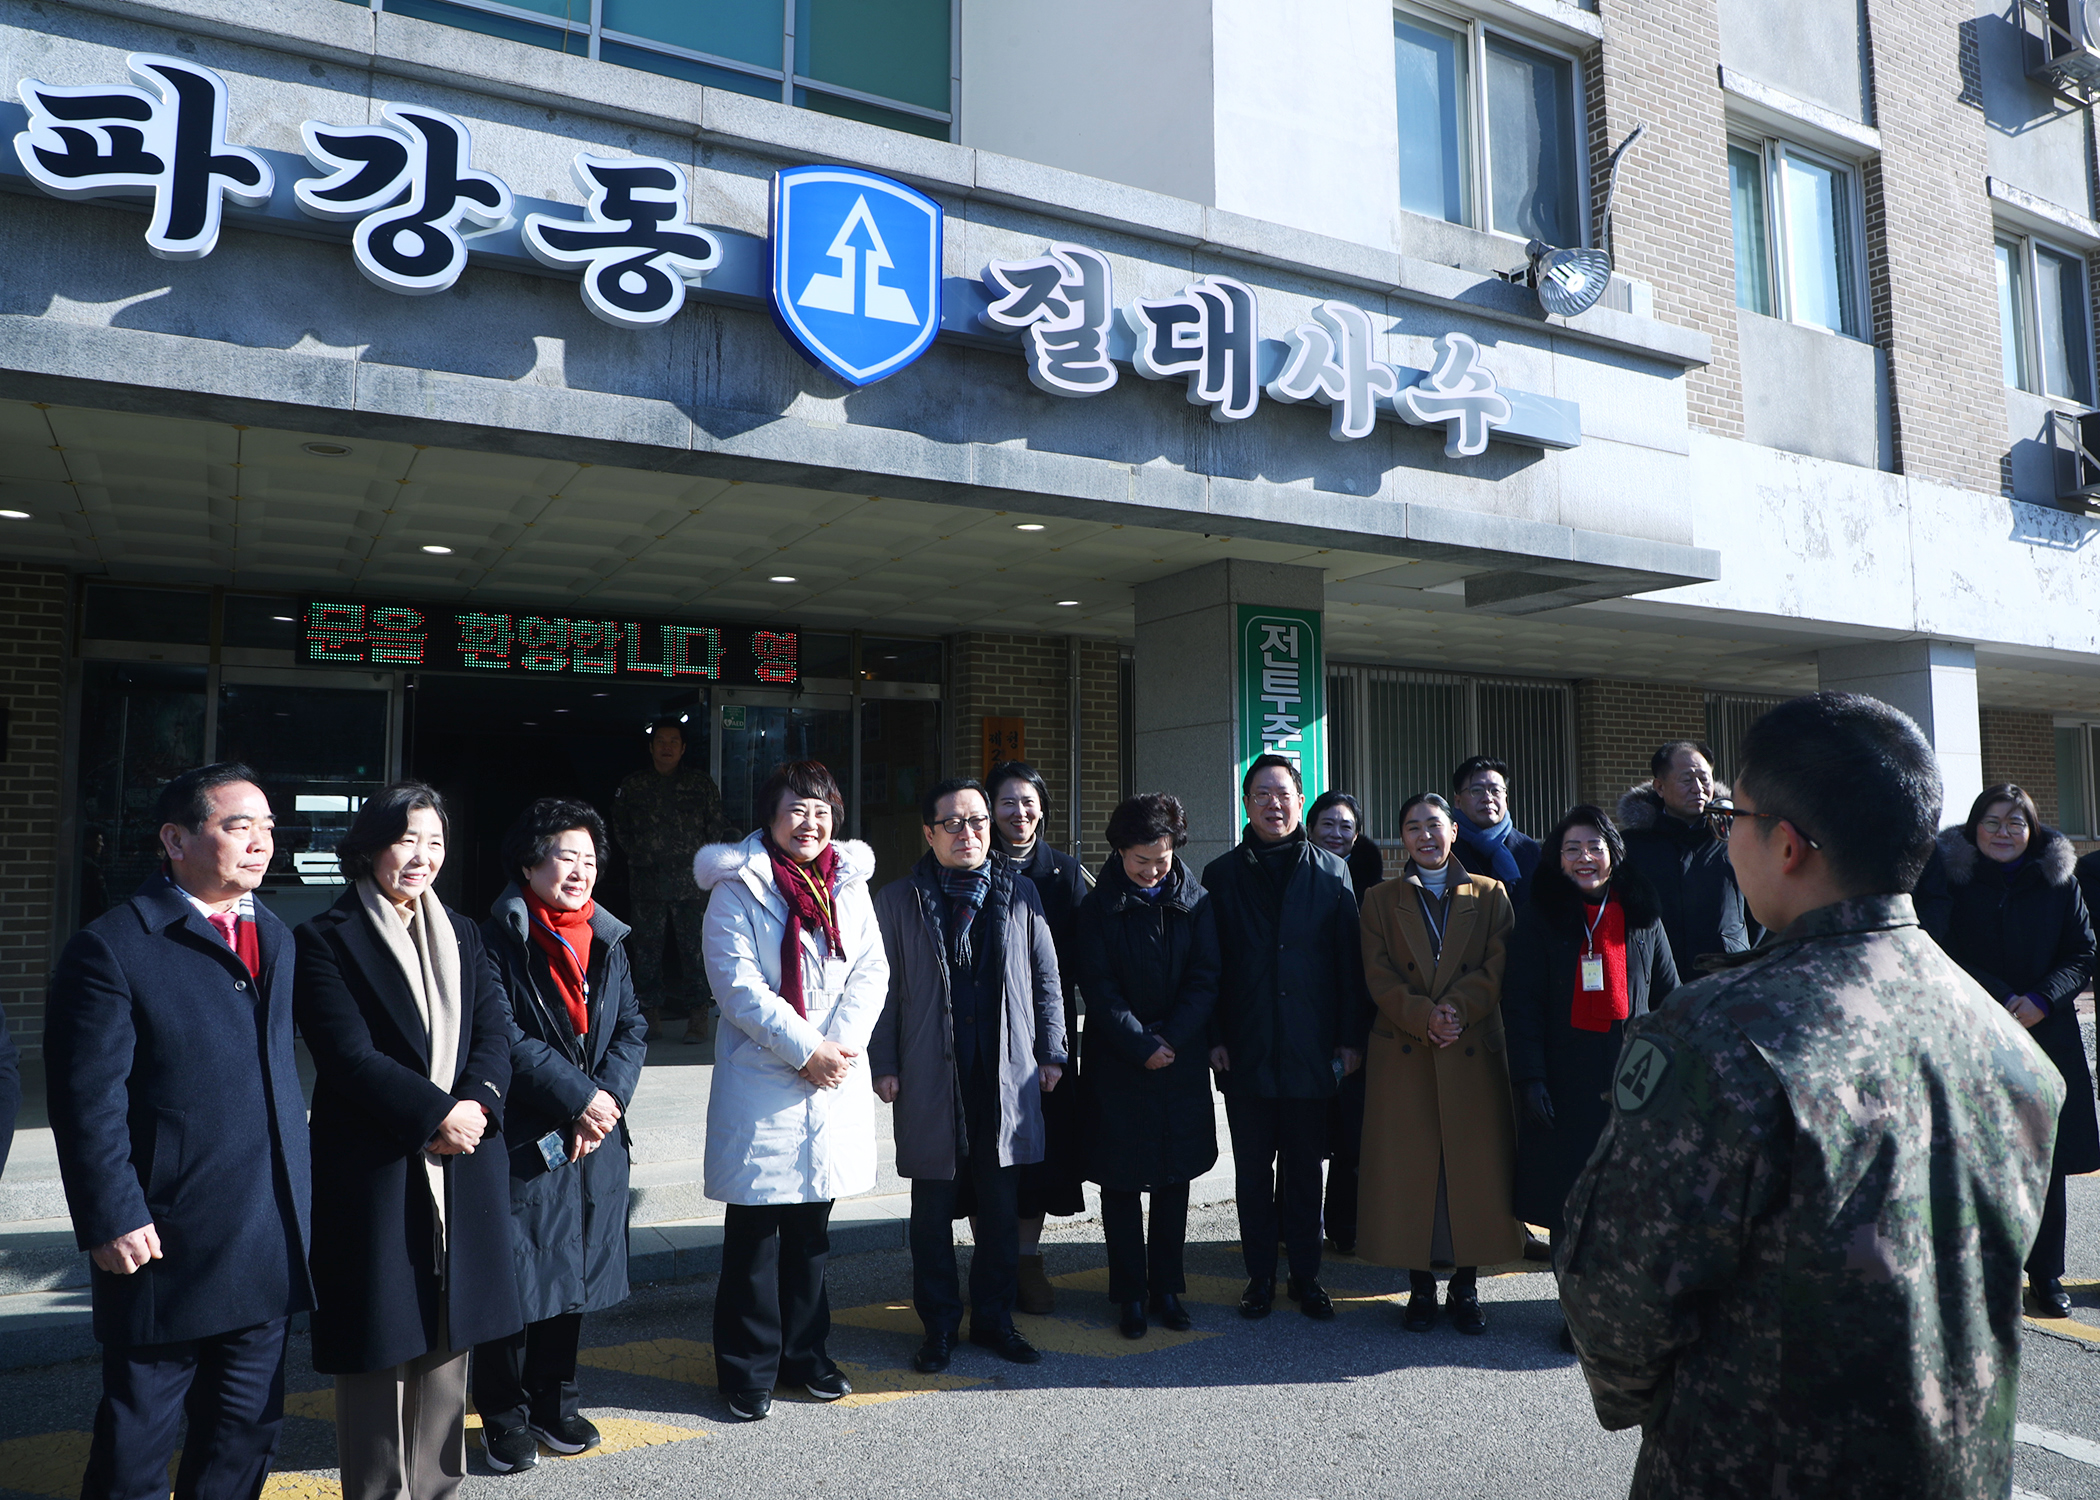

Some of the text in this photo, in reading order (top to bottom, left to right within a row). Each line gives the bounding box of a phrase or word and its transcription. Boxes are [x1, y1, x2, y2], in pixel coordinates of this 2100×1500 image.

[15, 53, 1512, 457] 파강동 절대사수
[304, 603, 427, 663] 문을
[455, 613, 725, 679] 환영합니다
[1259, 624, 1302, 773] 전투준
